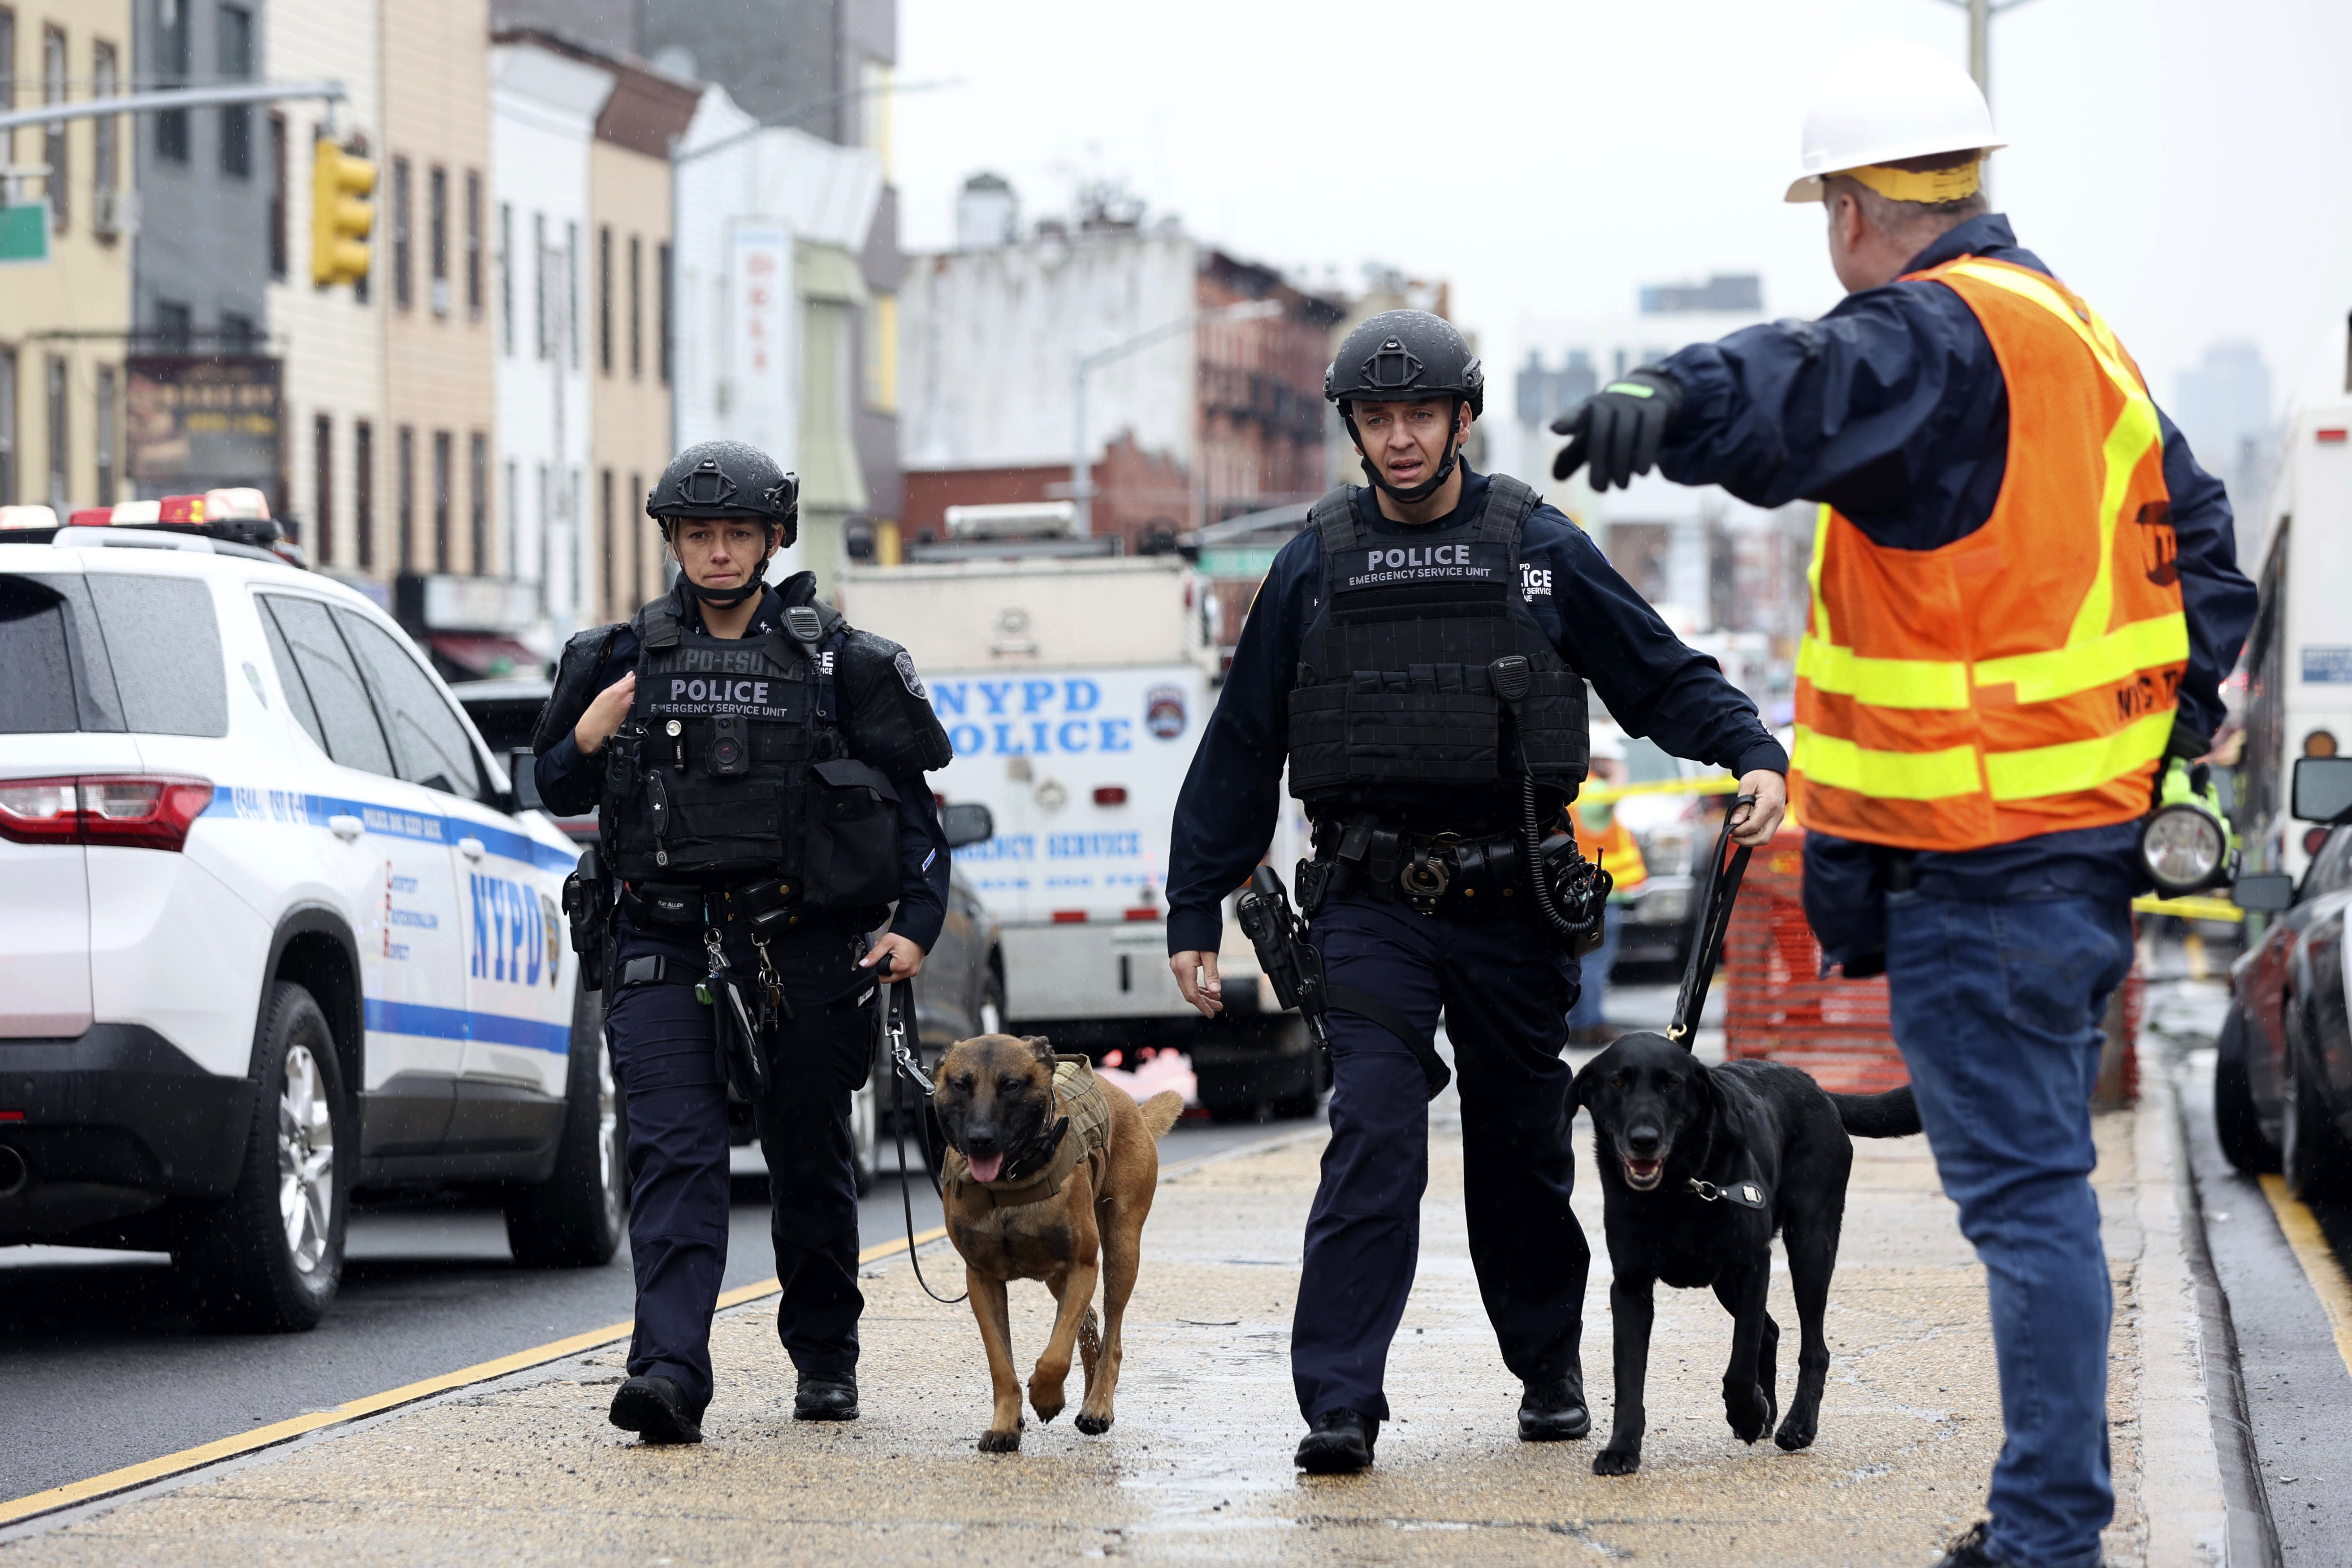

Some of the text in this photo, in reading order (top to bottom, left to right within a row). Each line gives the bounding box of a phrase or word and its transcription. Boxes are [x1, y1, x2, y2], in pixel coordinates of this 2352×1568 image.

[1368, 545, 1470, 571] POLICE
[1349, 567, 1492, 586] EMERGENCY SERVICE UNIT
[1522, 570, 1552, 587] ICE
[1527, 587, 1552, 596] SERVICE
[670, 679, 769, 704] POLICE
[934, 679, 1100, 716] NYPD
[716, 704, 760, 715] SERVICE
[762, 707, 787, 717] UNIT
[948, 718, 1133, 756] OLICE
[470, 872, 543, 987] NYPD
